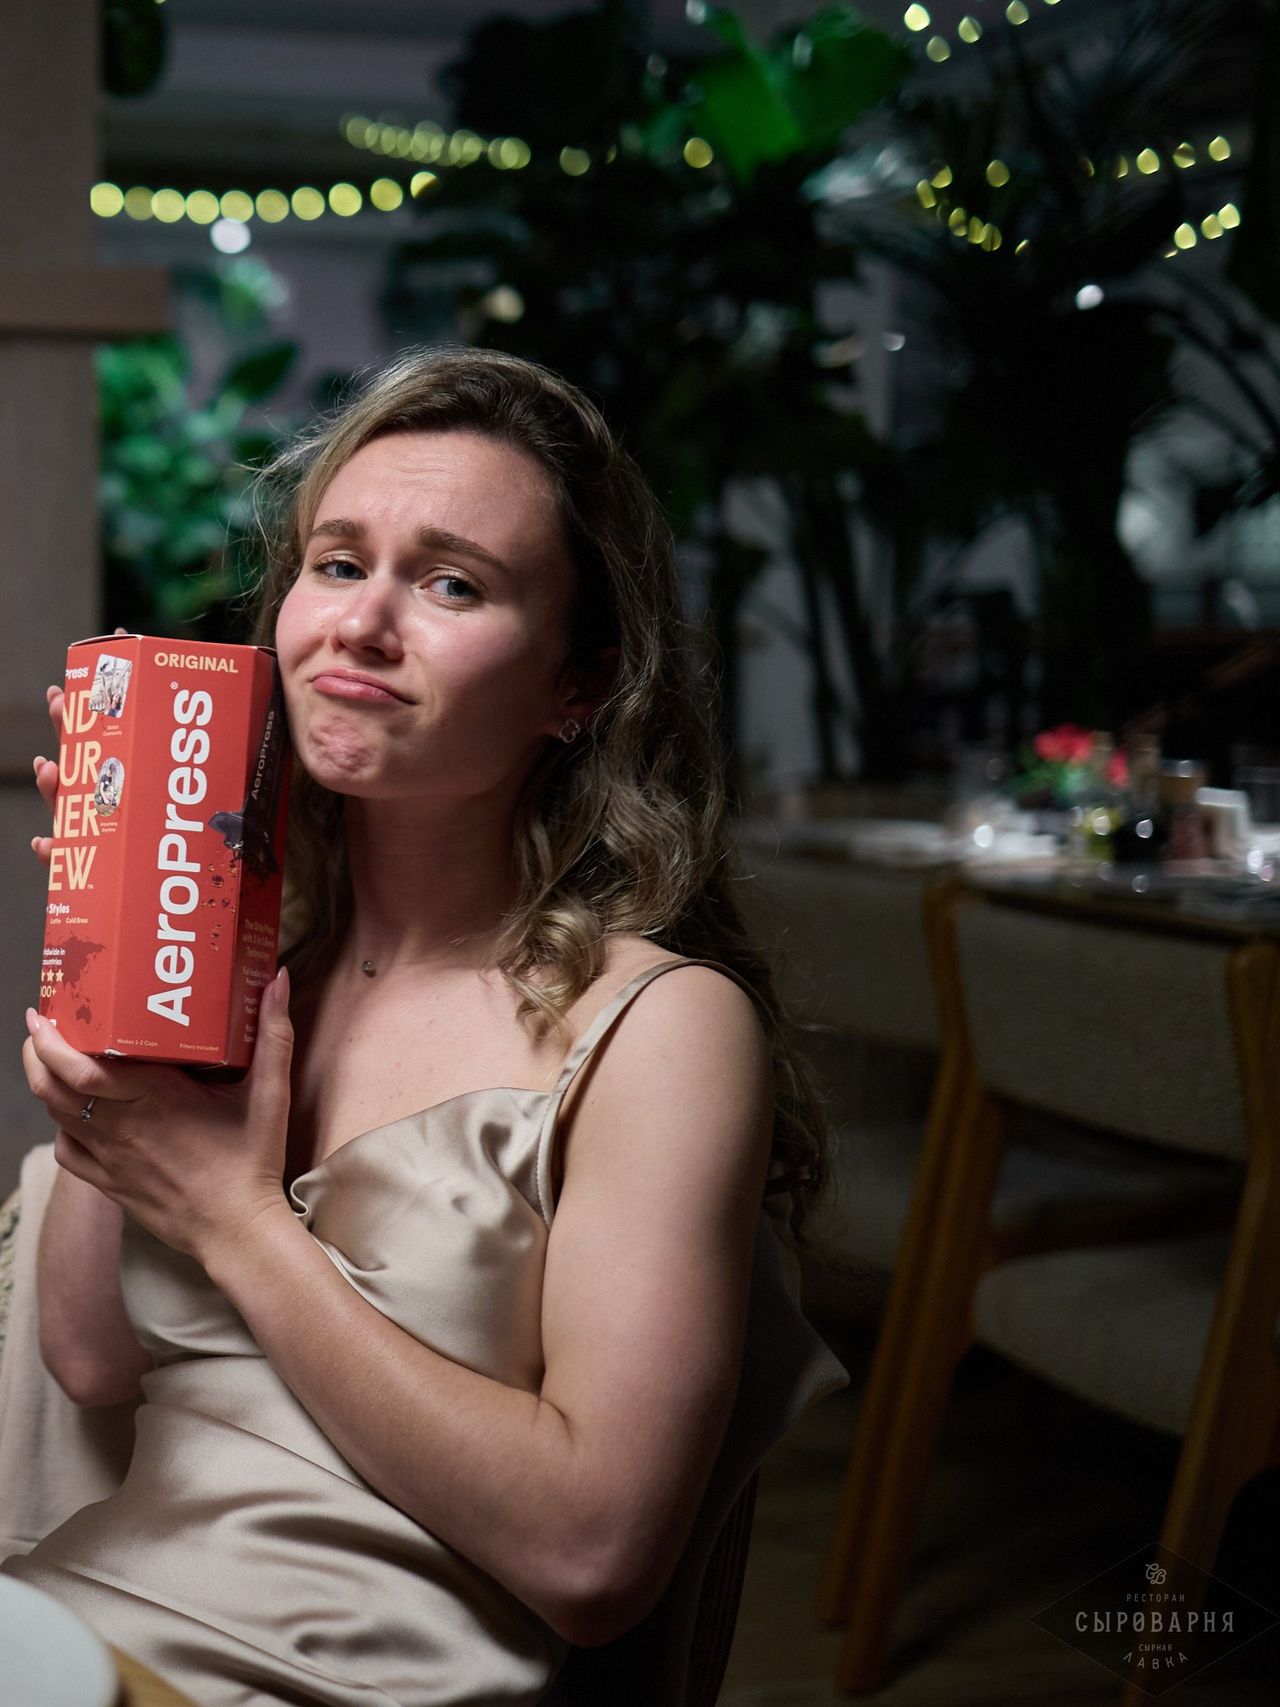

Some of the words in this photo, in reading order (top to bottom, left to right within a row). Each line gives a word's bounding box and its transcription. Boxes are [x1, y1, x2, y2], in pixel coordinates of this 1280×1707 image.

[154, 652, 239, 673] ORIGINAL
[59, 741, 102, 787] UR
[147, 689, 213, 1027] AeroPress
[49, 903, 70, 917] Styles
